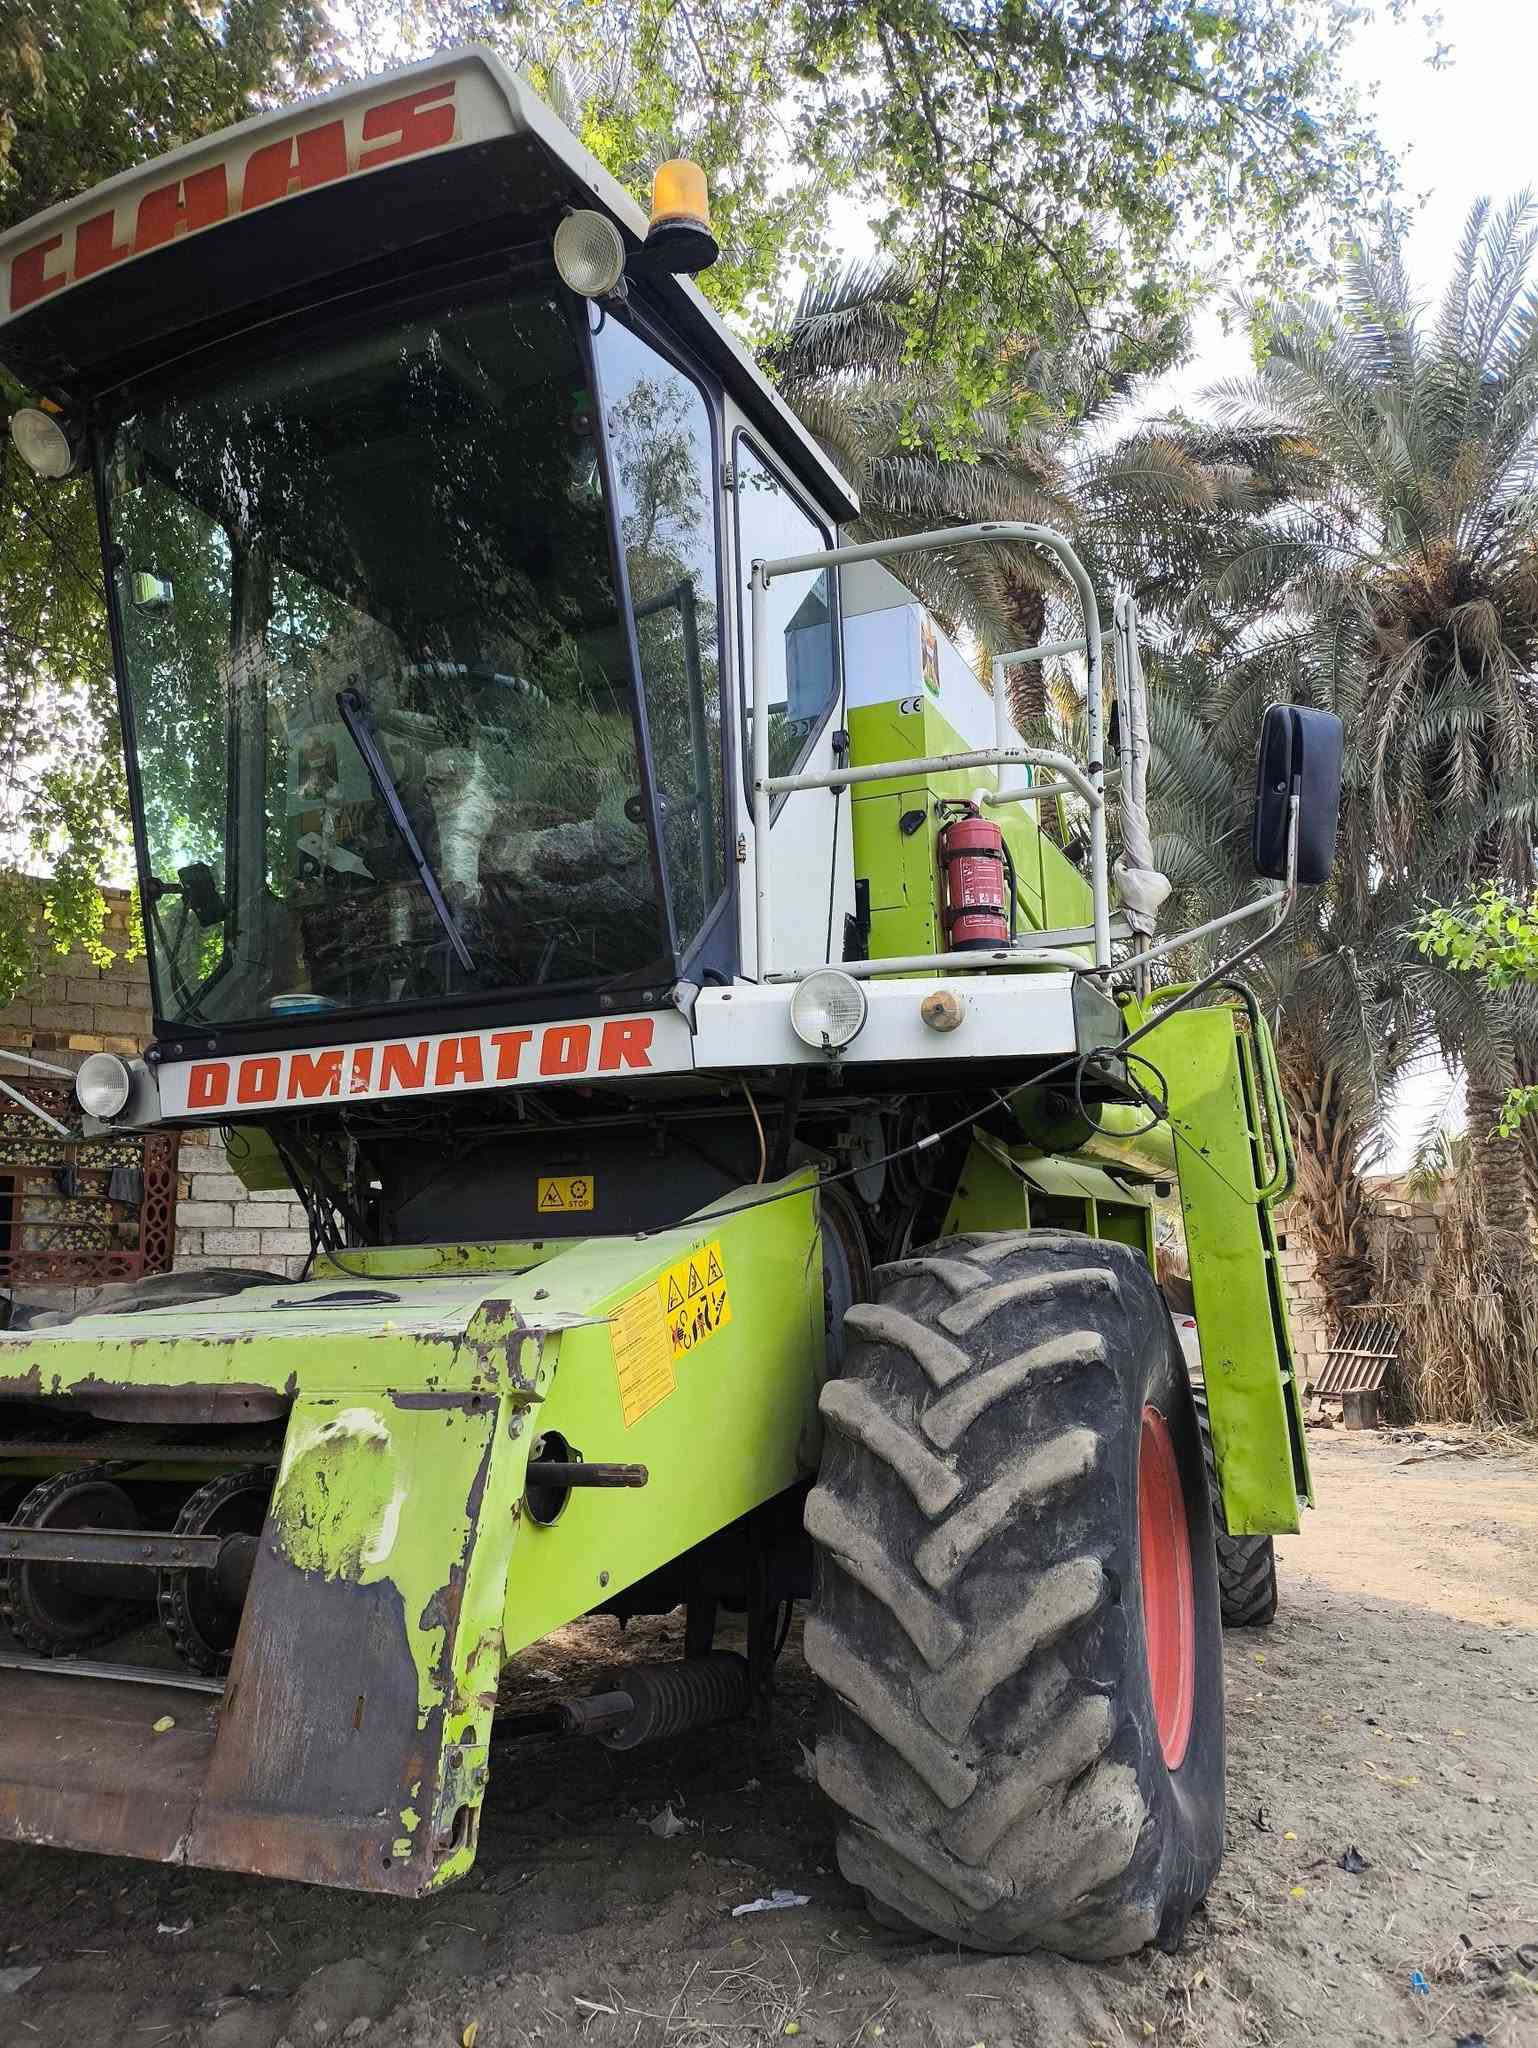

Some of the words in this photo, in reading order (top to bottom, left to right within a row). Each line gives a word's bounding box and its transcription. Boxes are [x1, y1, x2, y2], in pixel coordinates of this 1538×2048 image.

[9, 79, 456, 314] CLAAS
[900, 698, 921, 714] CE
[186, 1017, 655, 1109] DOMINATOR
[567, 1199, 591, 1209] STOP
